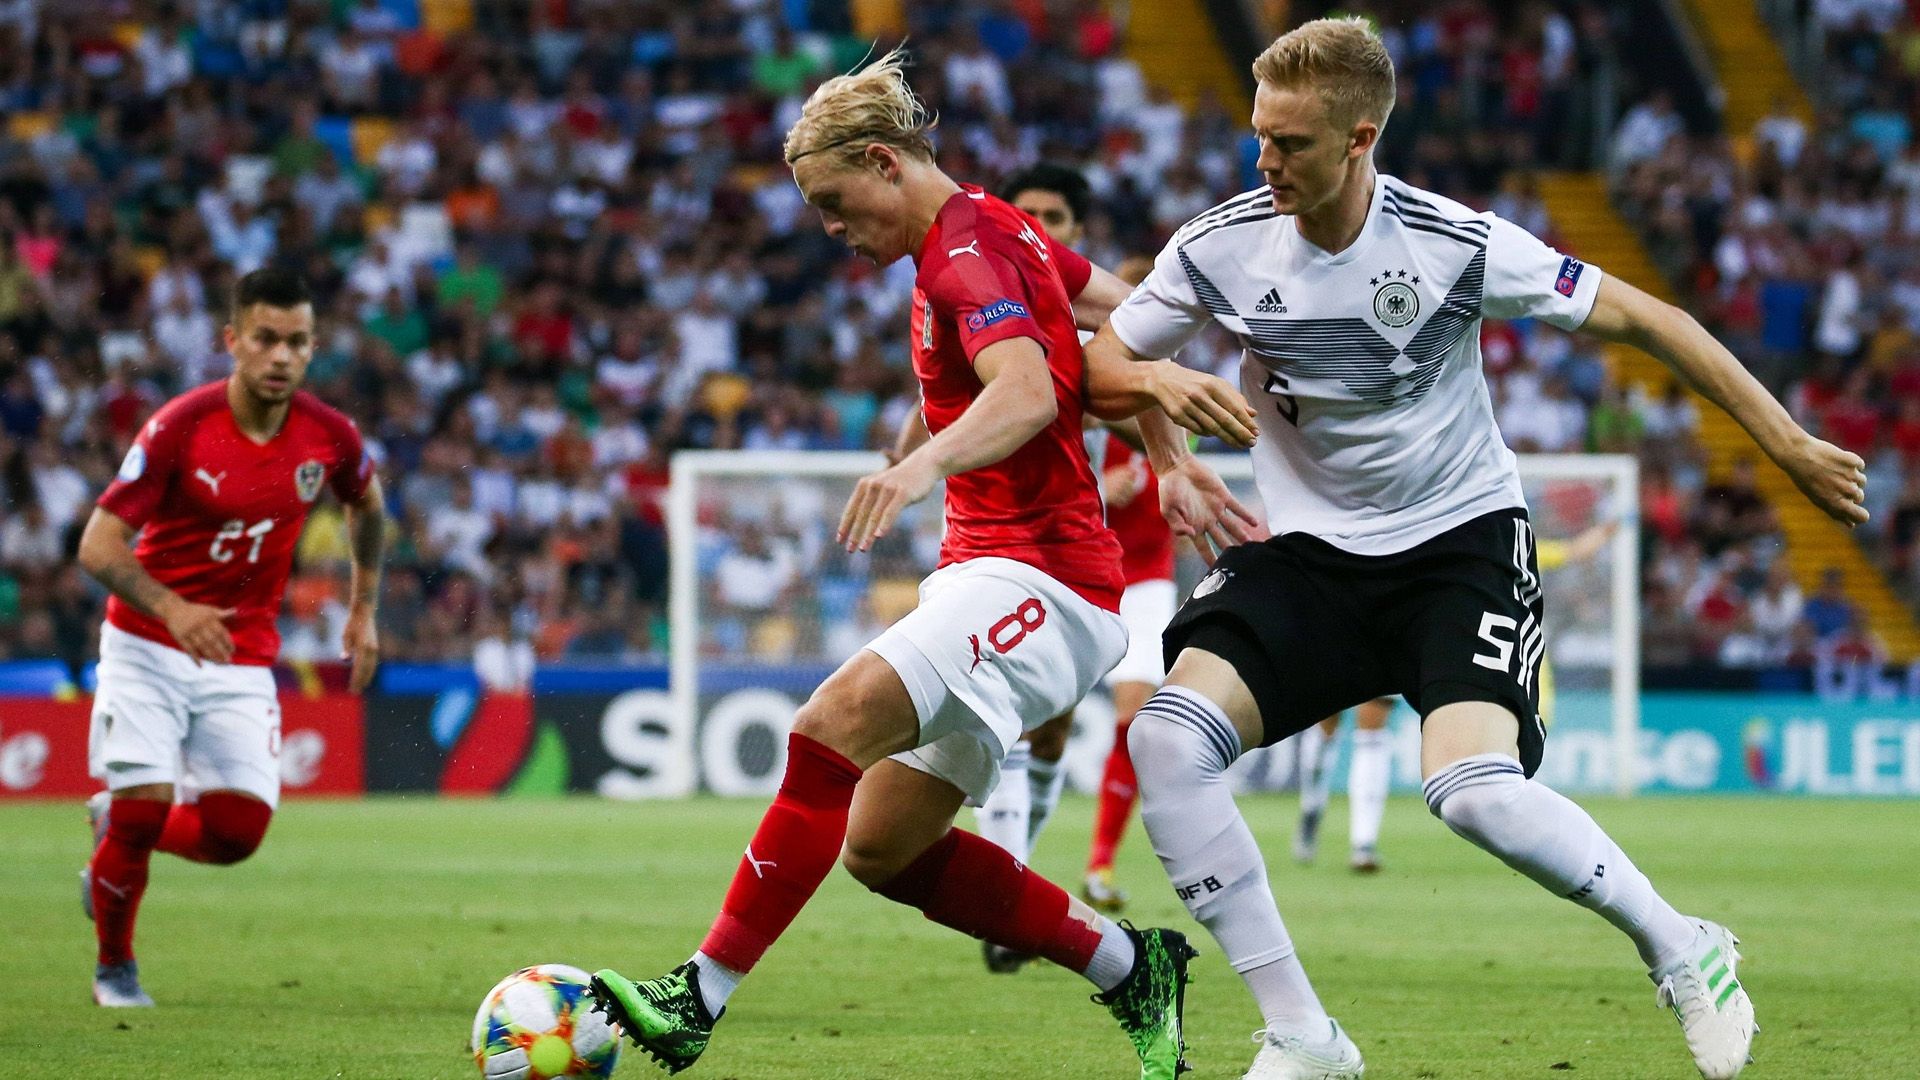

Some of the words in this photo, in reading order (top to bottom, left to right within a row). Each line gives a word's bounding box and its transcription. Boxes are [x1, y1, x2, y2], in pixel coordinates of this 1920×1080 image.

[985, 302, 1026, 320] RESPECT
[1255, 303, 1288, 314] adidas
[209, 518, 274, 563] 21
[988, 598, 1046, 654] 8
[1472, 611, 1518, 673] 5
